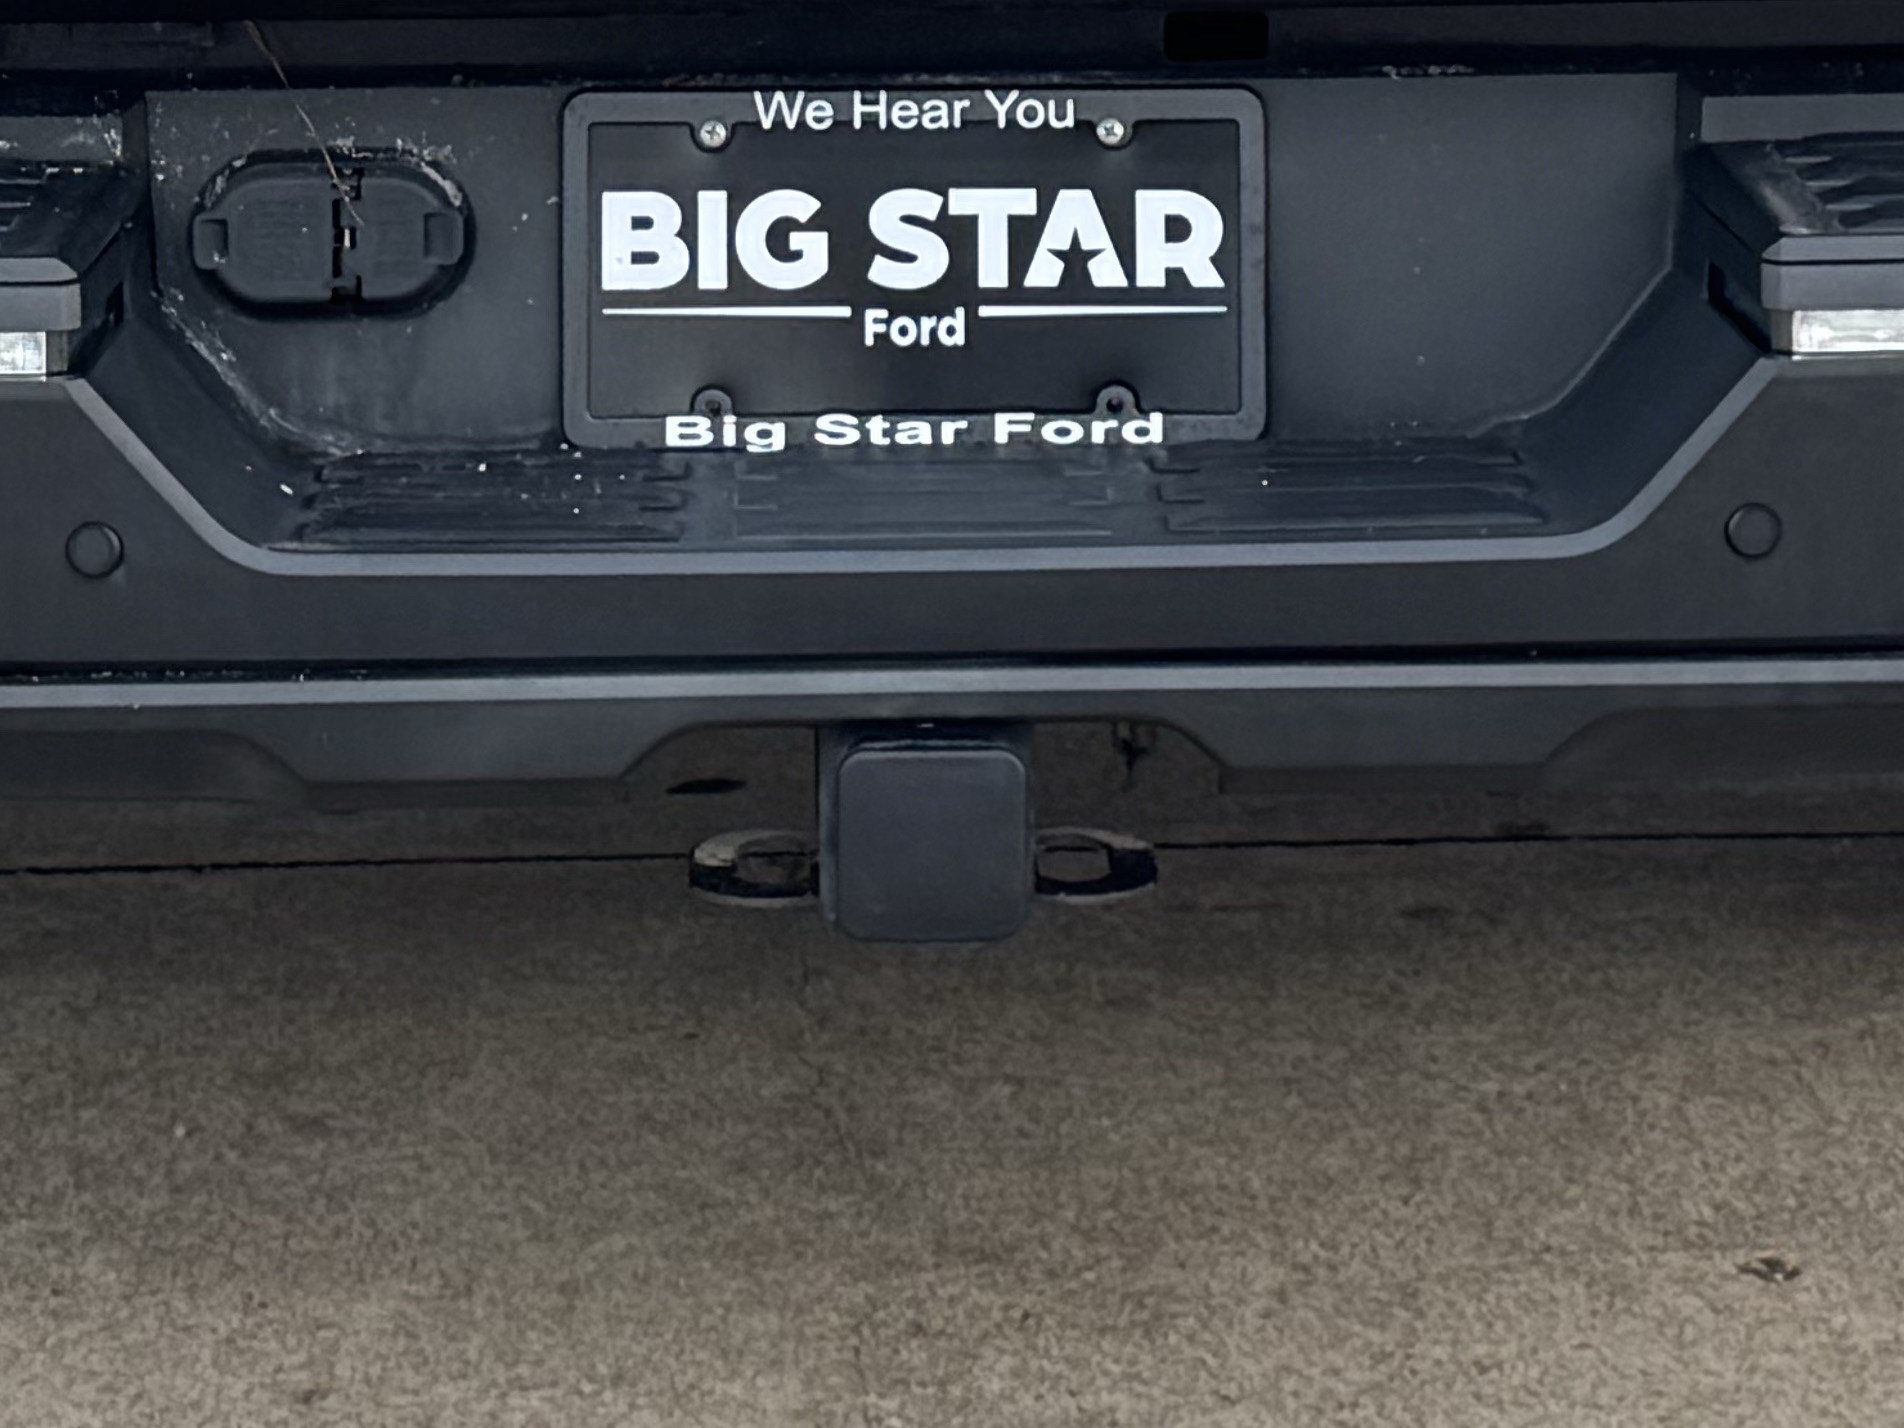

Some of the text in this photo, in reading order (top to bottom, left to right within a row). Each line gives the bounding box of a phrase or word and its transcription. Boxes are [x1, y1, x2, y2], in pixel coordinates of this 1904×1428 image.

[753, 89, 1076, 131] We Hear You
[601, 187, 1225, 292] BIG STAR
[863, 306, 966, 348] Ford
[665, 411, 1165, 453] Big Star Ford
